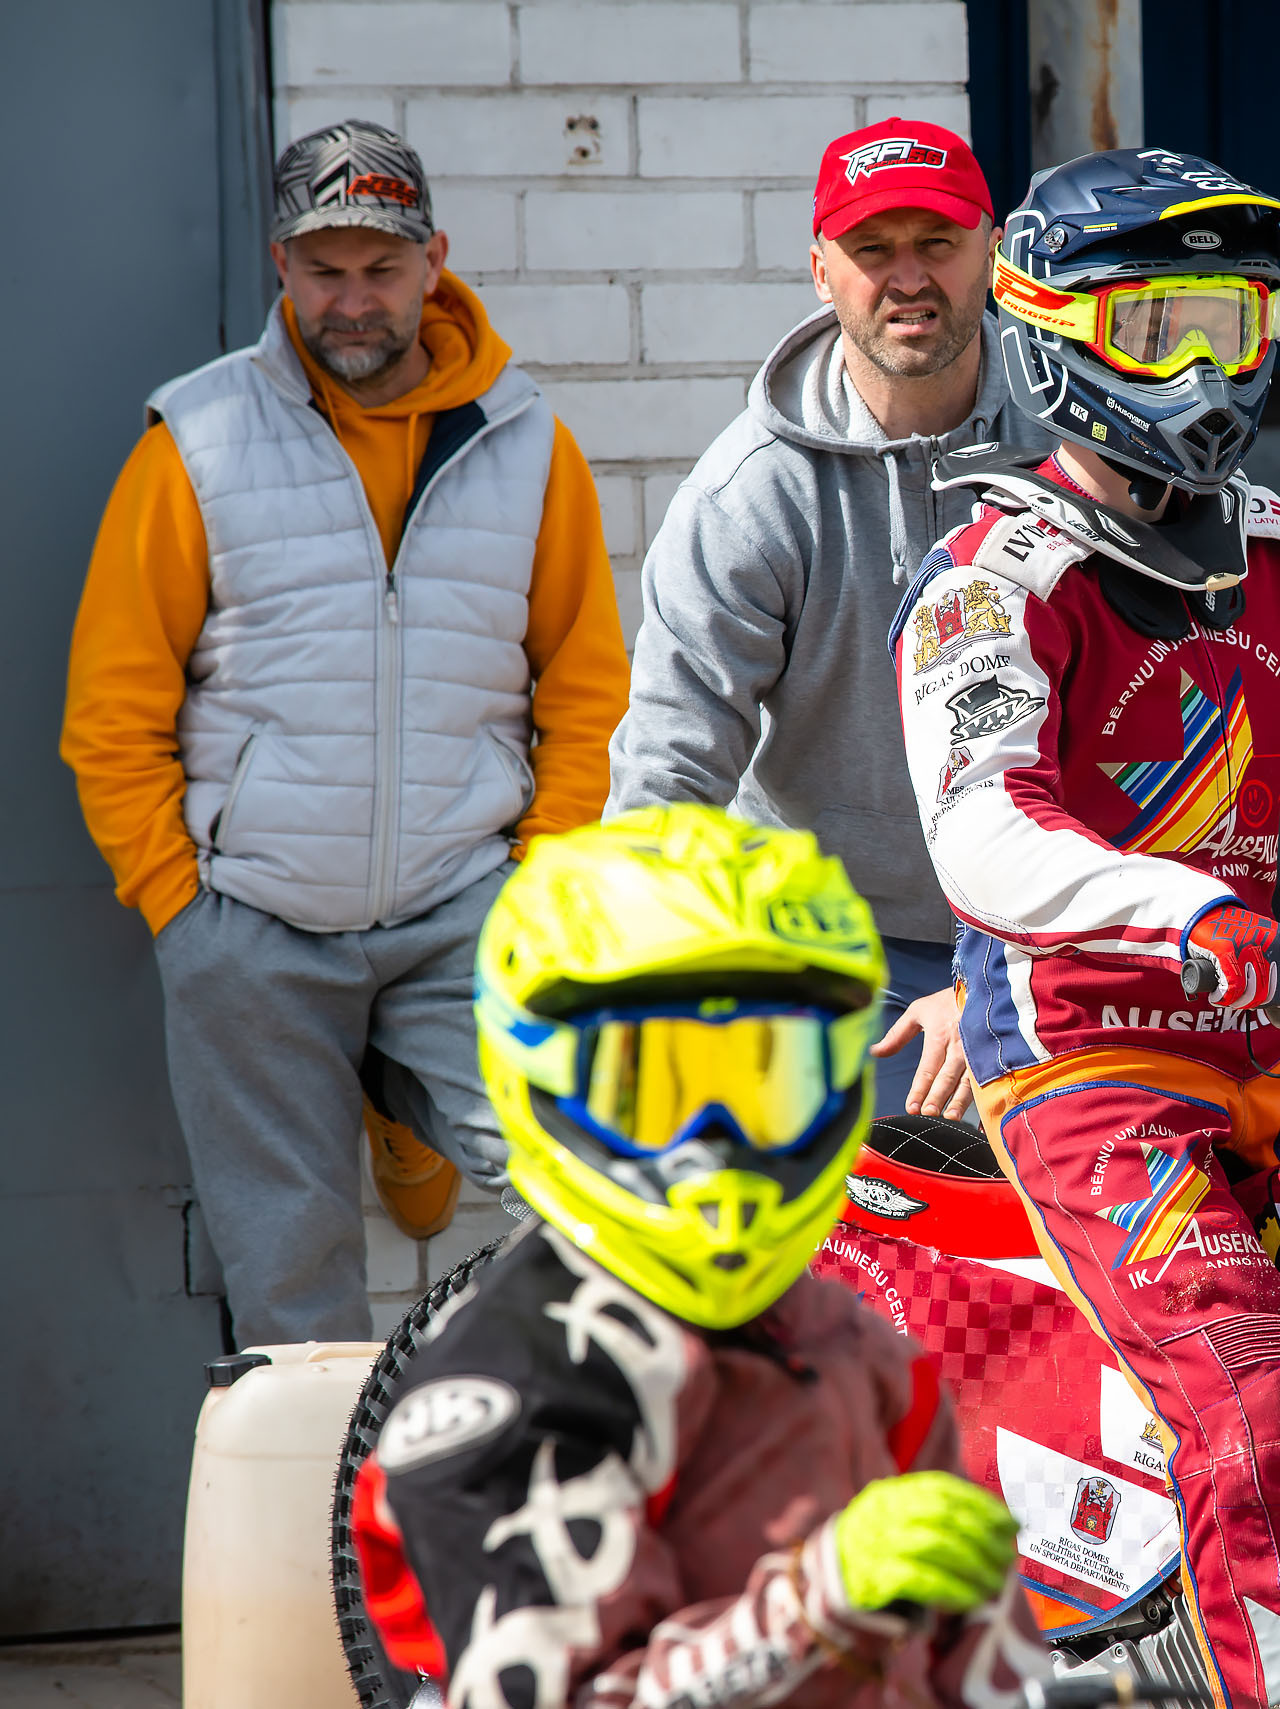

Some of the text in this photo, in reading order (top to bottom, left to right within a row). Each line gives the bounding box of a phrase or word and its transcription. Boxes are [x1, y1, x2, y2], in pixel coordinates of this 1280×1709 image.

[1189, 235, 1216, 245] BELL
[1073, 404, 1087, 417] TK
[1148, 640, 1171, 663] UN
[1212, 863, 1249, 878] ANNO
[1091, 1140, 1115, 1195] BĒRNU
[1114, 1125, 1137, 1141] UN
[814, 1237, 888, 1287] JAUNIEŠU
[1128, 1268, 1154, 1290] IK
[1059, 1536, 1110, 1564] RĪGAS DOMES
[1030, 1544, 1130, 1592] UN SPORTA DEPARTAMENTS
[1084, 1557, 1124, 1580] KULTŪRAS
